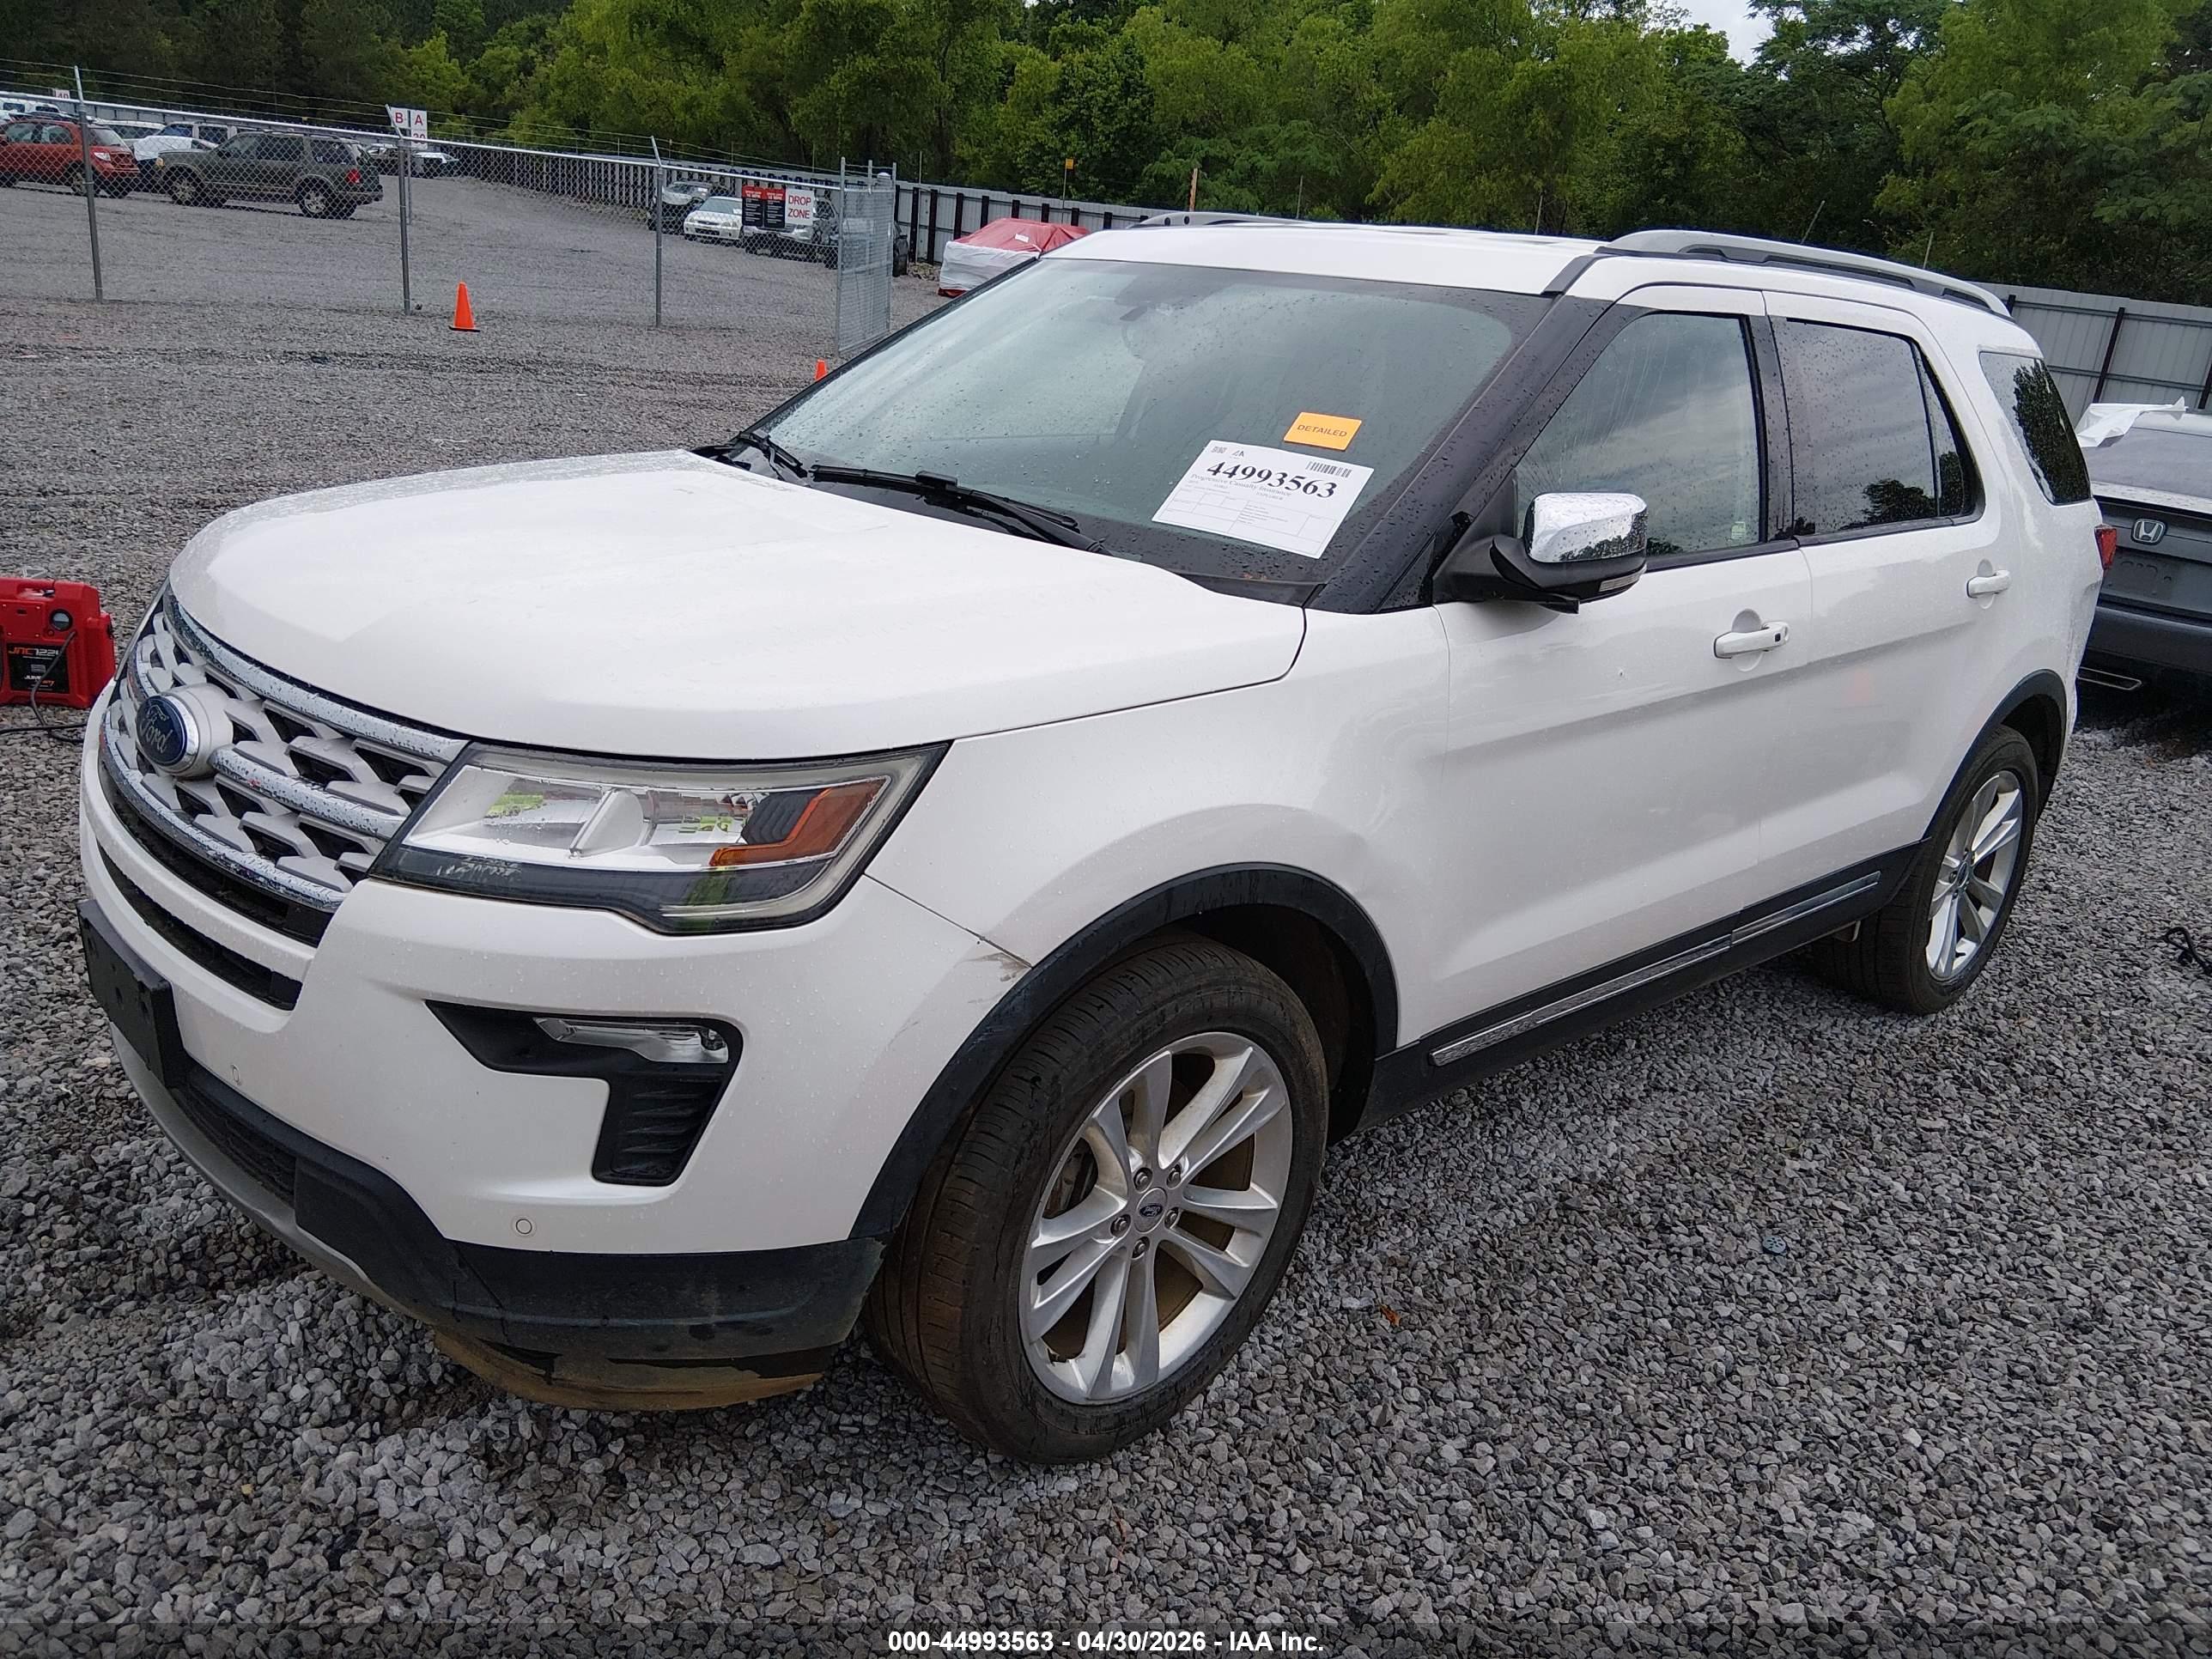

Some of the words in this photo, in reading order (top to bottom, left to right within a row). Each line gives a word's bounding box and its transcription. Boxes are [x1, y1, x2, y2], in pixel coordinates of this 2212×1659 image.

[395, 112, 404, 124] B
[415, 114, 423, 125] A
[788, 195, 811, 206] DROP
[787, 209, 811, 219] ZONE
[1297, 424, 1347, 438] DETAILED
[1190, 473, 1229, 483] Progressive
[1229, 481, 1258, 491] Casualty
[1259, 486, 1292, 496] Insurance
[1206, 461, 1338, 499] 44993563
[140, 704, 173, 754] Ford
